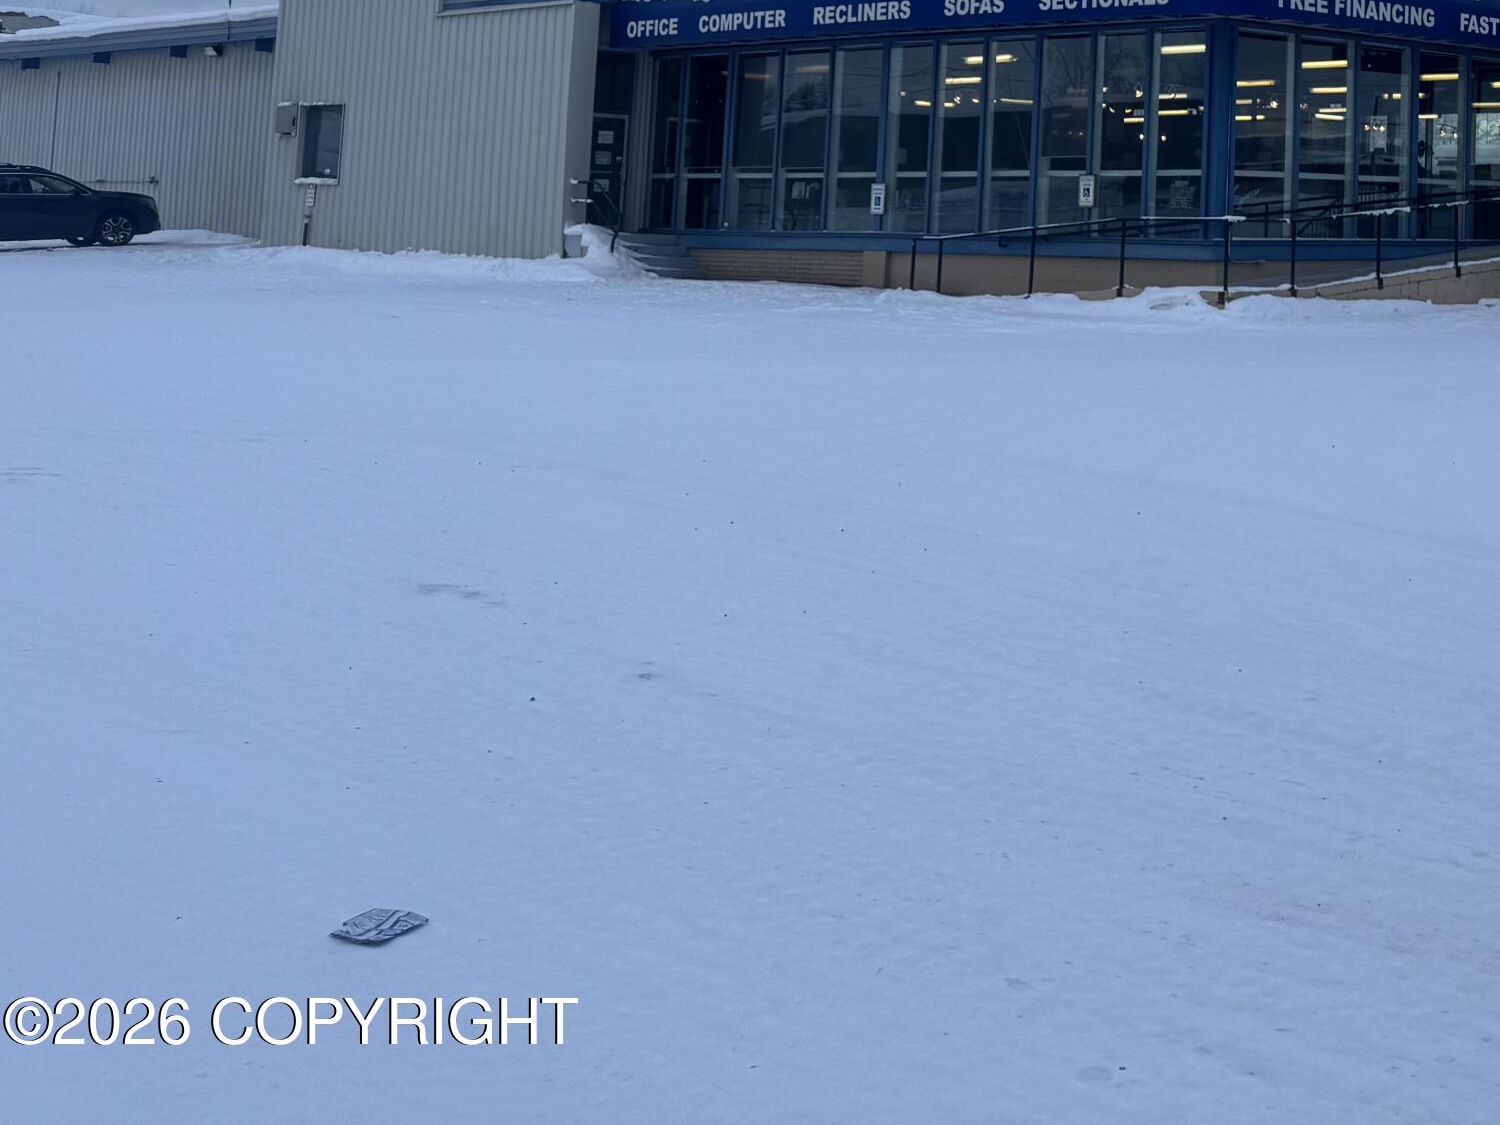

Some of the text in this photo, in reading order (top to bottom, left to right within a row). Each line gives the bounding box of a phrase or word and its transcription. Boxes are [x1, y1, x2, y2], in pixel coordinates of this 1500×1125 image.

[626, 17, 679, 39] OFFICE
[697, 9, 787, 33] COMPUTER
[812, 0, 912, 26] RECLINERS
[1460, 13, 1500, 36] FAST
